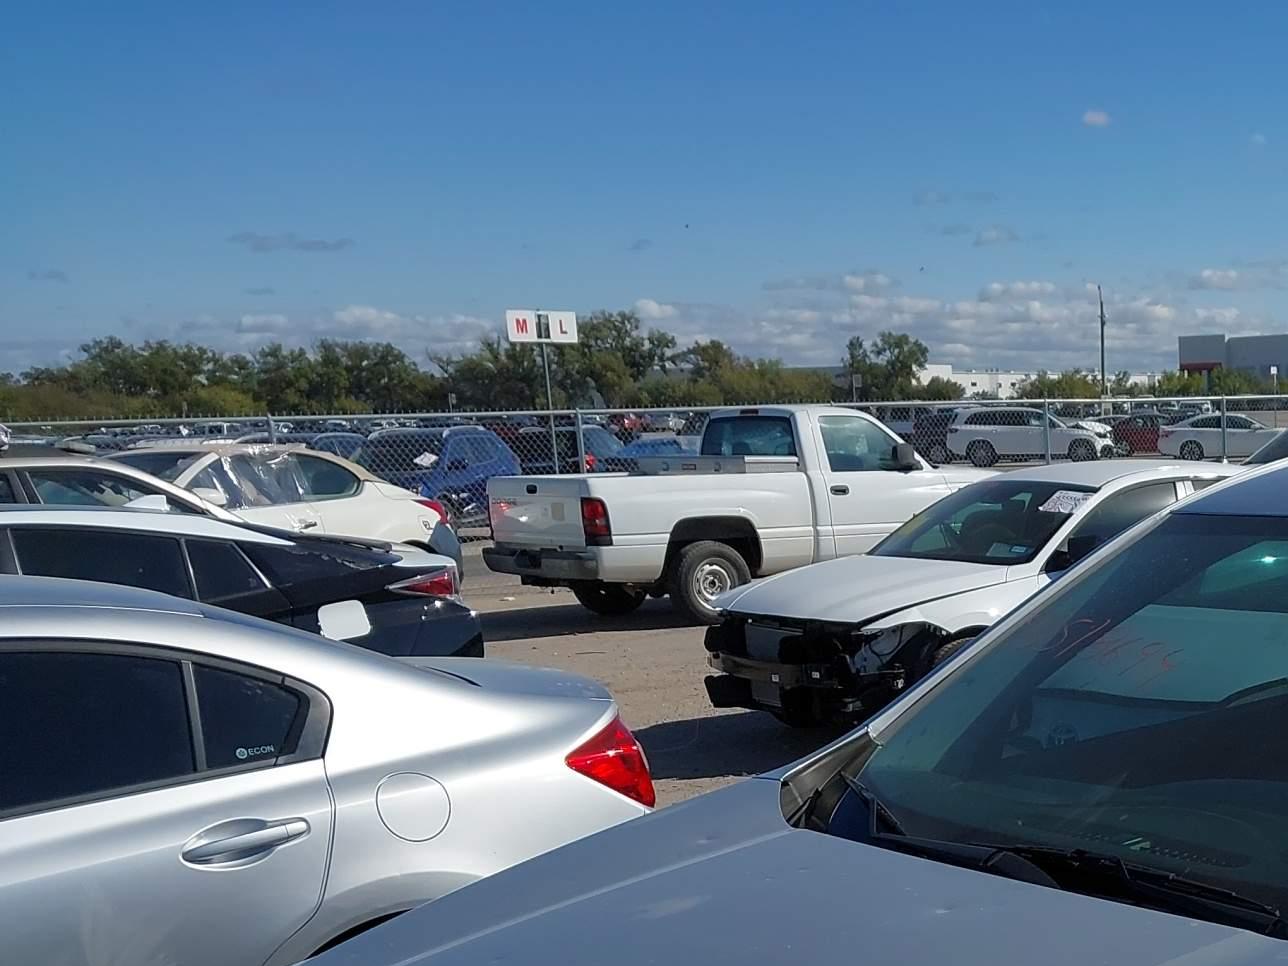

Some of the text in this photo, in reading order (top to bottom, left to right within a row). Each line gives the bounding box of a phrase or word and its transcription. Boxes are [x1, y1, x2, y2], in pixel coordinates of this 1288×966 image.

[515, 318, 568, 335] M L
[248, 745, 275, 756] ECON
